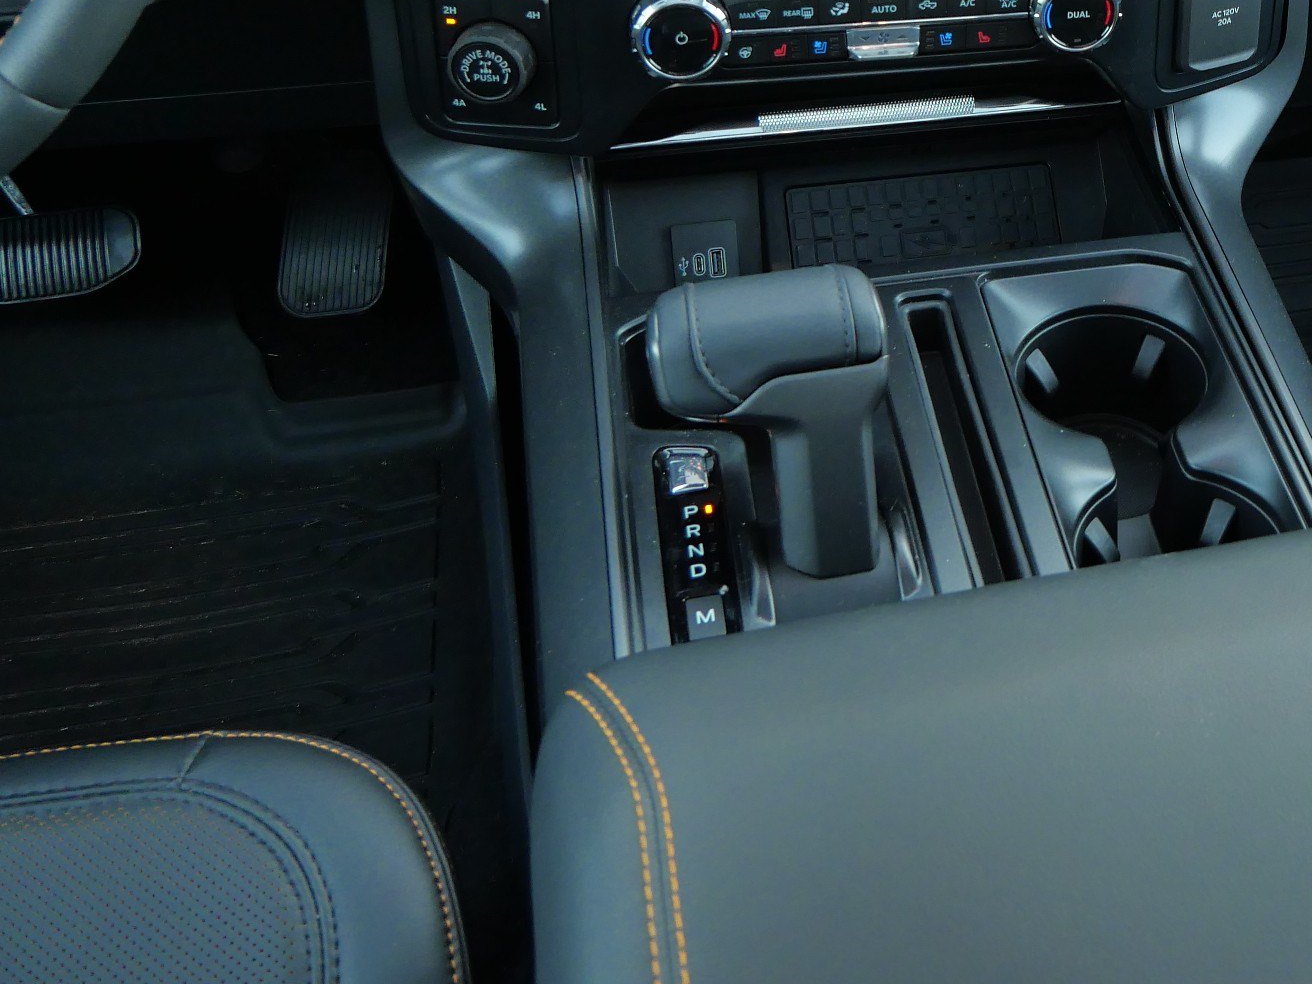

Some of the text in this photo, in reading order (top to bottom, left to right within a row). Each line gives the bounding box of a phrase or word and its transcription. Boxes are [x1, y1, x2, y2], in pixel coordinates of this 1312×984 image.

[871, 4, 897, 15] AUTO
[1000, 0, 1017, 9] A/C
[443, 6, 457, 15] 2H
[526, 11, 541, 20] 4H
[738, 10, 756, 20] MAX
[782, 8, 802, 19] REAR
[1067, 10, 1091, 20] DUAL
[1211, 7, 1240, 19] AC 120V
[1217, 17, 1232, 26] 20A
[460, 49, 512, 74] DRIVE MODE
[473, 73, 500, 83] PUSH
[452, 98, 467, 107] 4A
[534, 102, 547, 111] 4L
[683, 505, 699, 519] P
[686, 524, 701, 539] R
[688, 543, 705, 559] N
[690, 563, 707, 579] D
[695, 608, 716, 625] M
